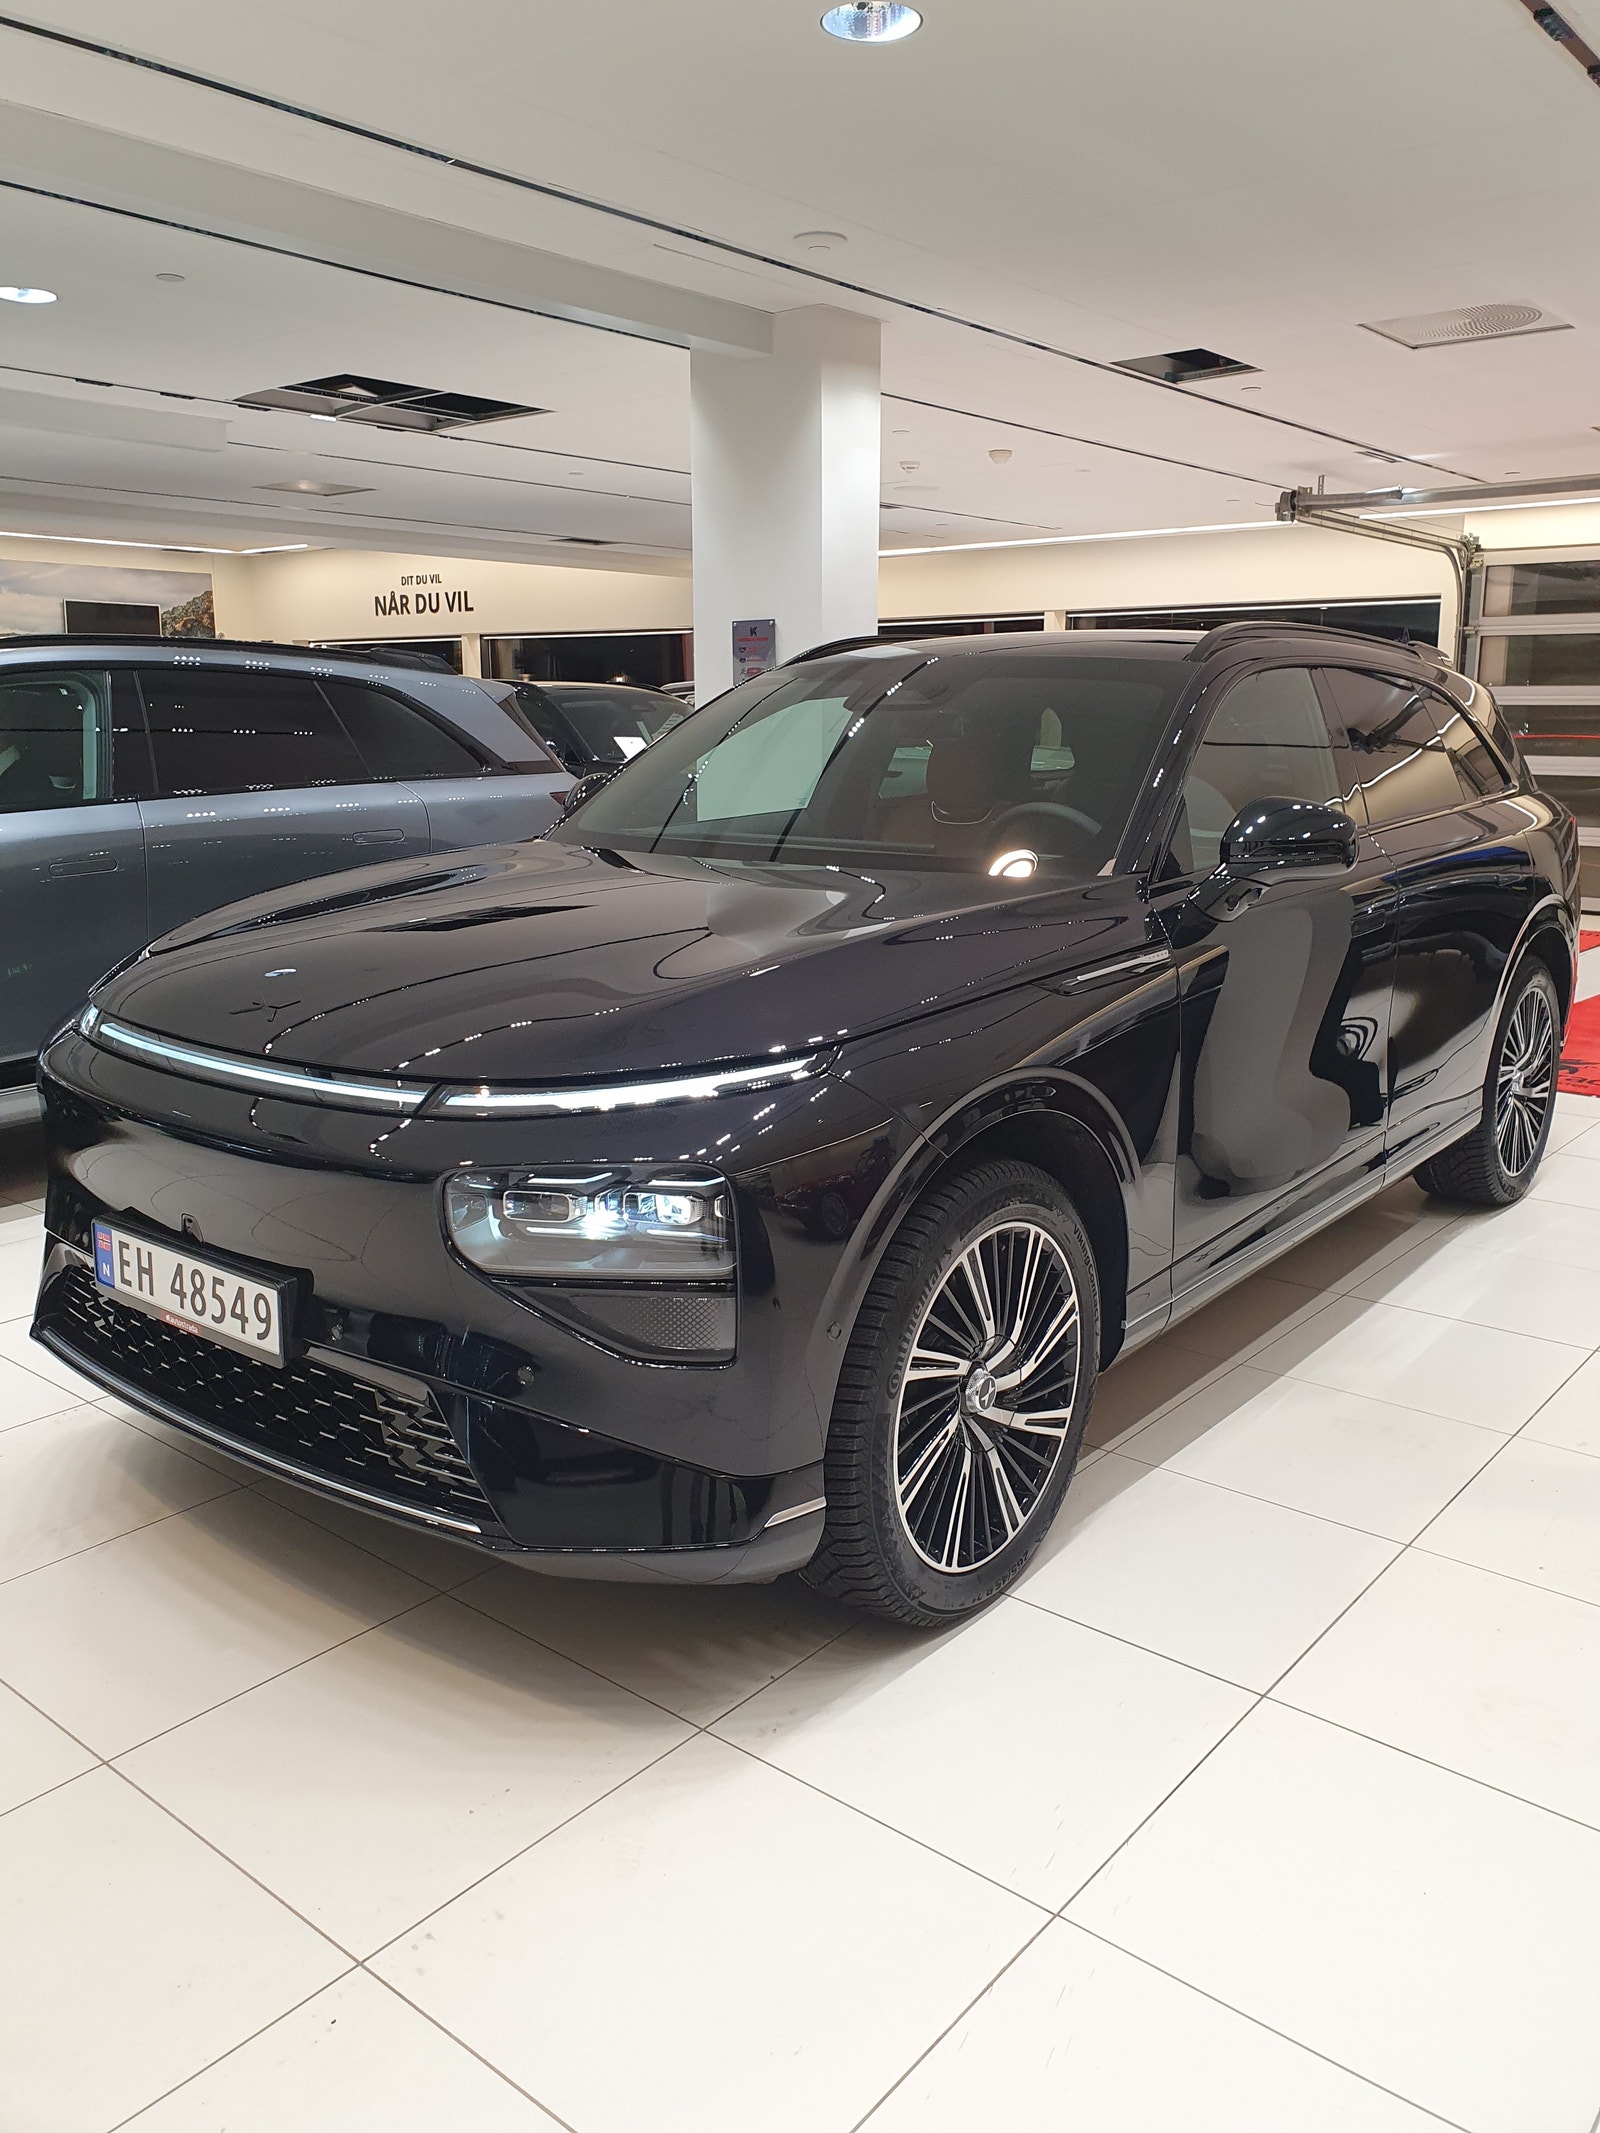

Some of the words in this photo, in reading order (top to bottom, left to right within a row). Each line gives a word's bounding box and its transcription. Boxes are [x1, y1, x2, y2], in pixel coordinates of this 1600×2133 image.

[401, 575, 414, 586] DIT
[416, 574, 428, 585] DU
[429, 573, 442, 585] VIL
[374, 590, 411, 616] NÅR
[415, 592, 440, 614] DU
[444, 590, 474, 613] VIL
[102, 1262, 111, 1278] N
[118, 1240, 155, 1297] EH
[170, 1262, 272, 1341] 48549
